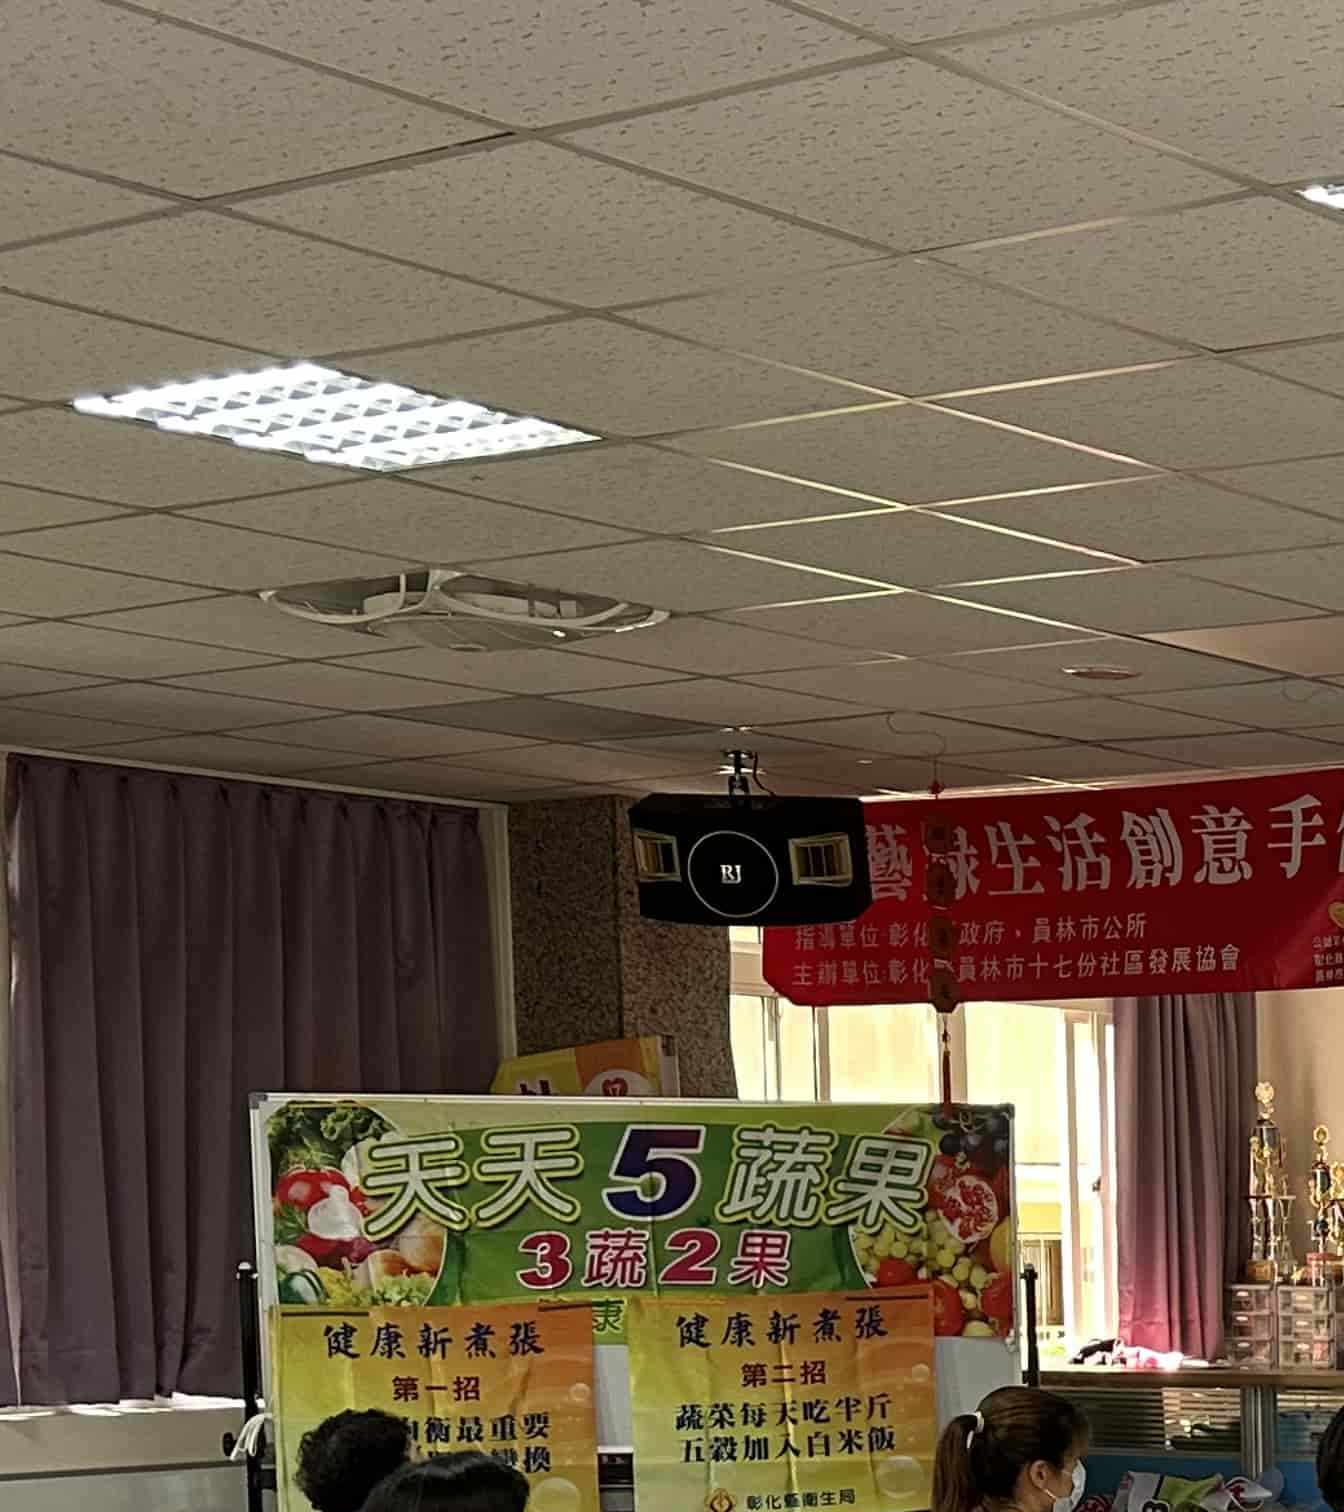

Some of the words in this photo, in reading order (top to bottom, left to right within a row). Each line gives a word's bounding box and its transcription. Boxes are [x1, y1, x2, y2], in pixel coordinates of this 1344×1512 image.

[360, 1124, 936, 1241] 天天5蔬果
[517, 1229, 793, 1289] 3蔬2果
[323, 1320, 545, 1359] 健康新煮張
[676, 1304, 888, 1348] 健康新煮張
[392, 1376, 481, 1402] 第一招
[741, 1360, 826, 1388] 第二招
[676, 1393, 893, 1431] 蔬菜每天吃半斤
[681, 1426, 896, 1463] 五穀加入白米飯
